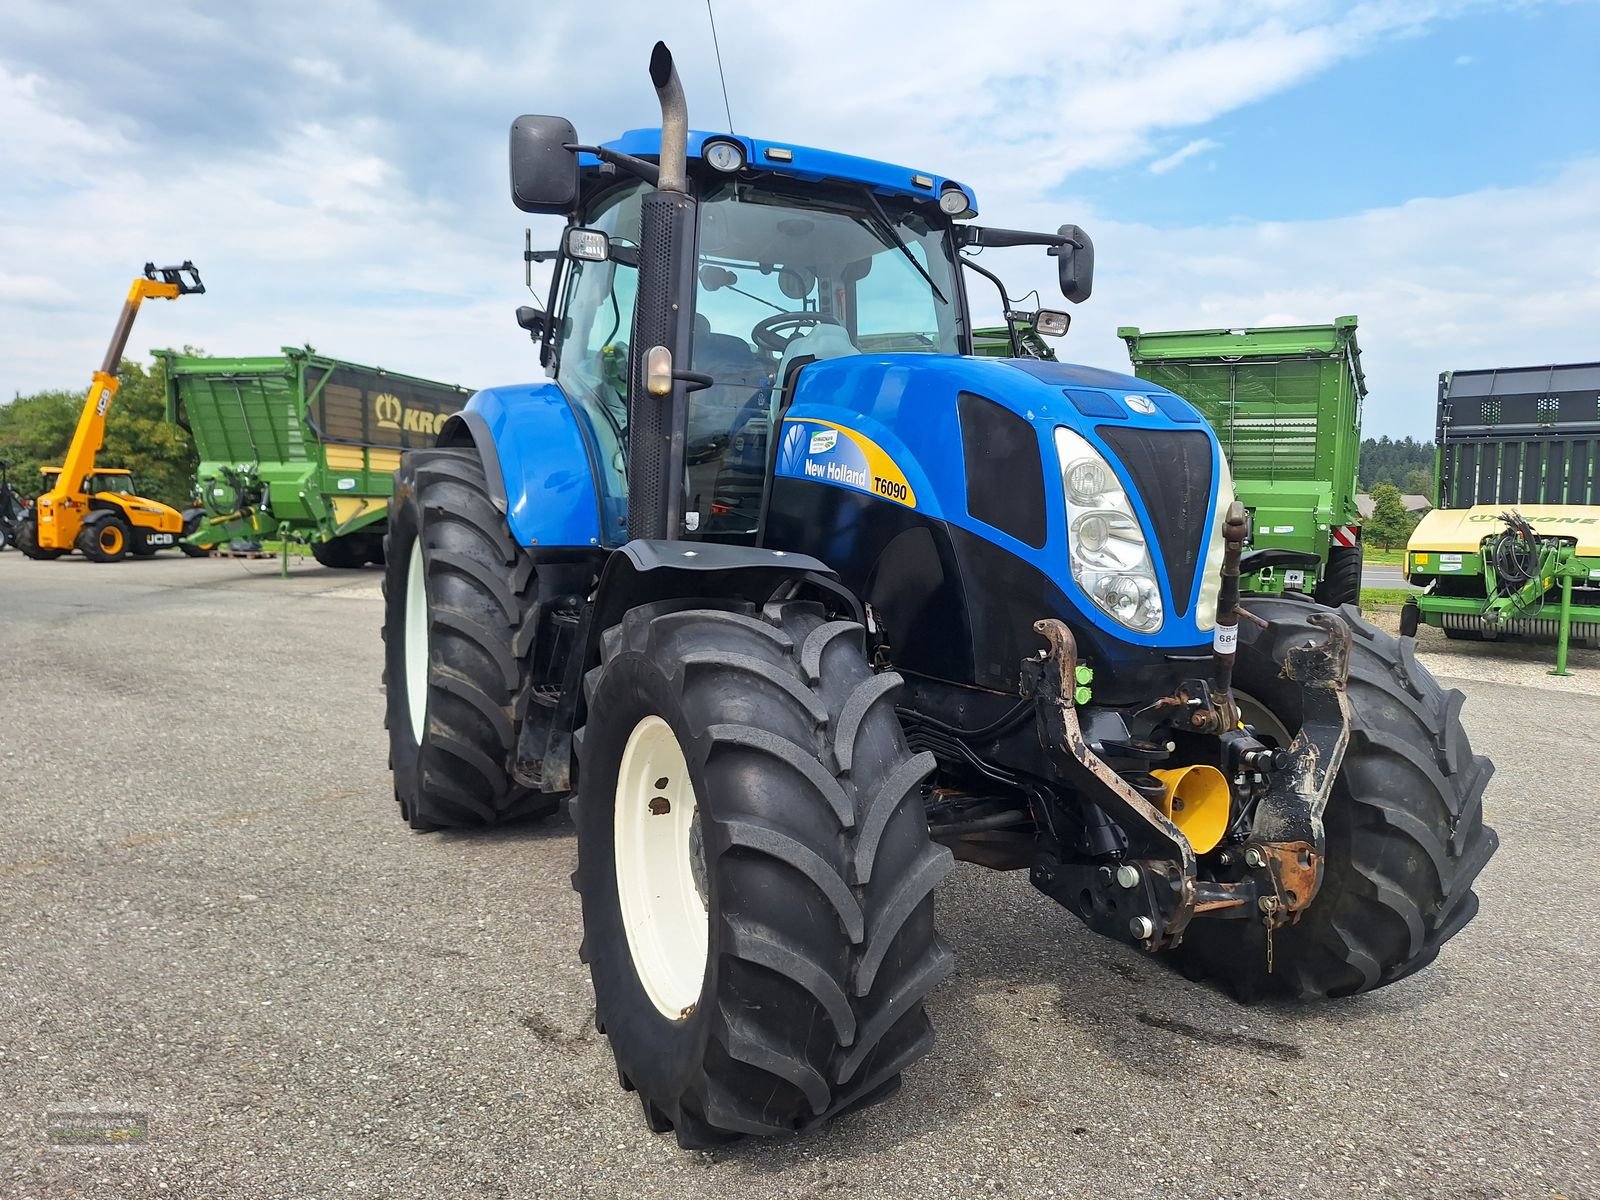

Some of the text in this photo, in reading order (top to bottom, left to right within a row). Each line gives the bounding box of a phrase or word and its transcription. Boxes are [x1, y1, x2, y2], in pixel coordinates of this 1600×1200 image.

[97, 389, 110, 416] JCB
[805, 459, 866, 487] New Holland
[874, 476, 907, 501] T6090
[1519, 516, 1599, 525] RONE
[146, 533, 173, 545] JCB
